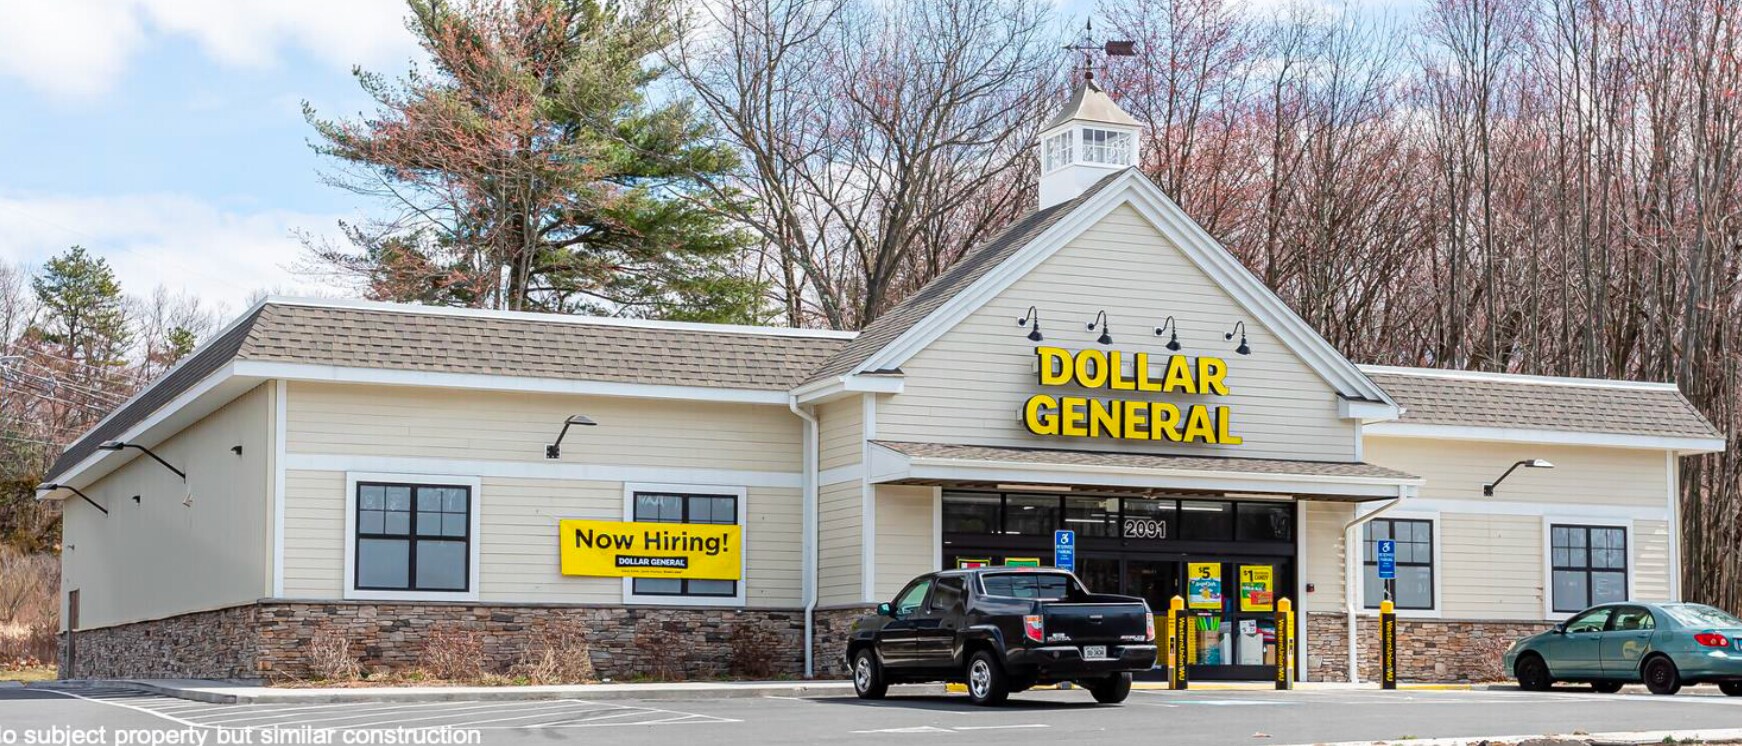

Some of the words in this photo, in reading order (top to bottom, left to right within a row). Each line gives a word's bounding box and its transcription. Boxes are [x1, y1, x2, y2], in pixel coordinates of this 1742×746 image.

[1035, 345, 1230, 396] DOLLAR
[1023, 394, 1243, 445] GENERAL
[1124, 519, 1166, 539] 2091
[575, 528, 634, 549] Now
[644, 531, 728, 556] Hiring!
[618, 557, 649, 565] DOLLAR
[651, 558, 685, 567] GENERAL
[1198, 566, 1210, 579] $5
[1243, 569, 1253, 582] $1
